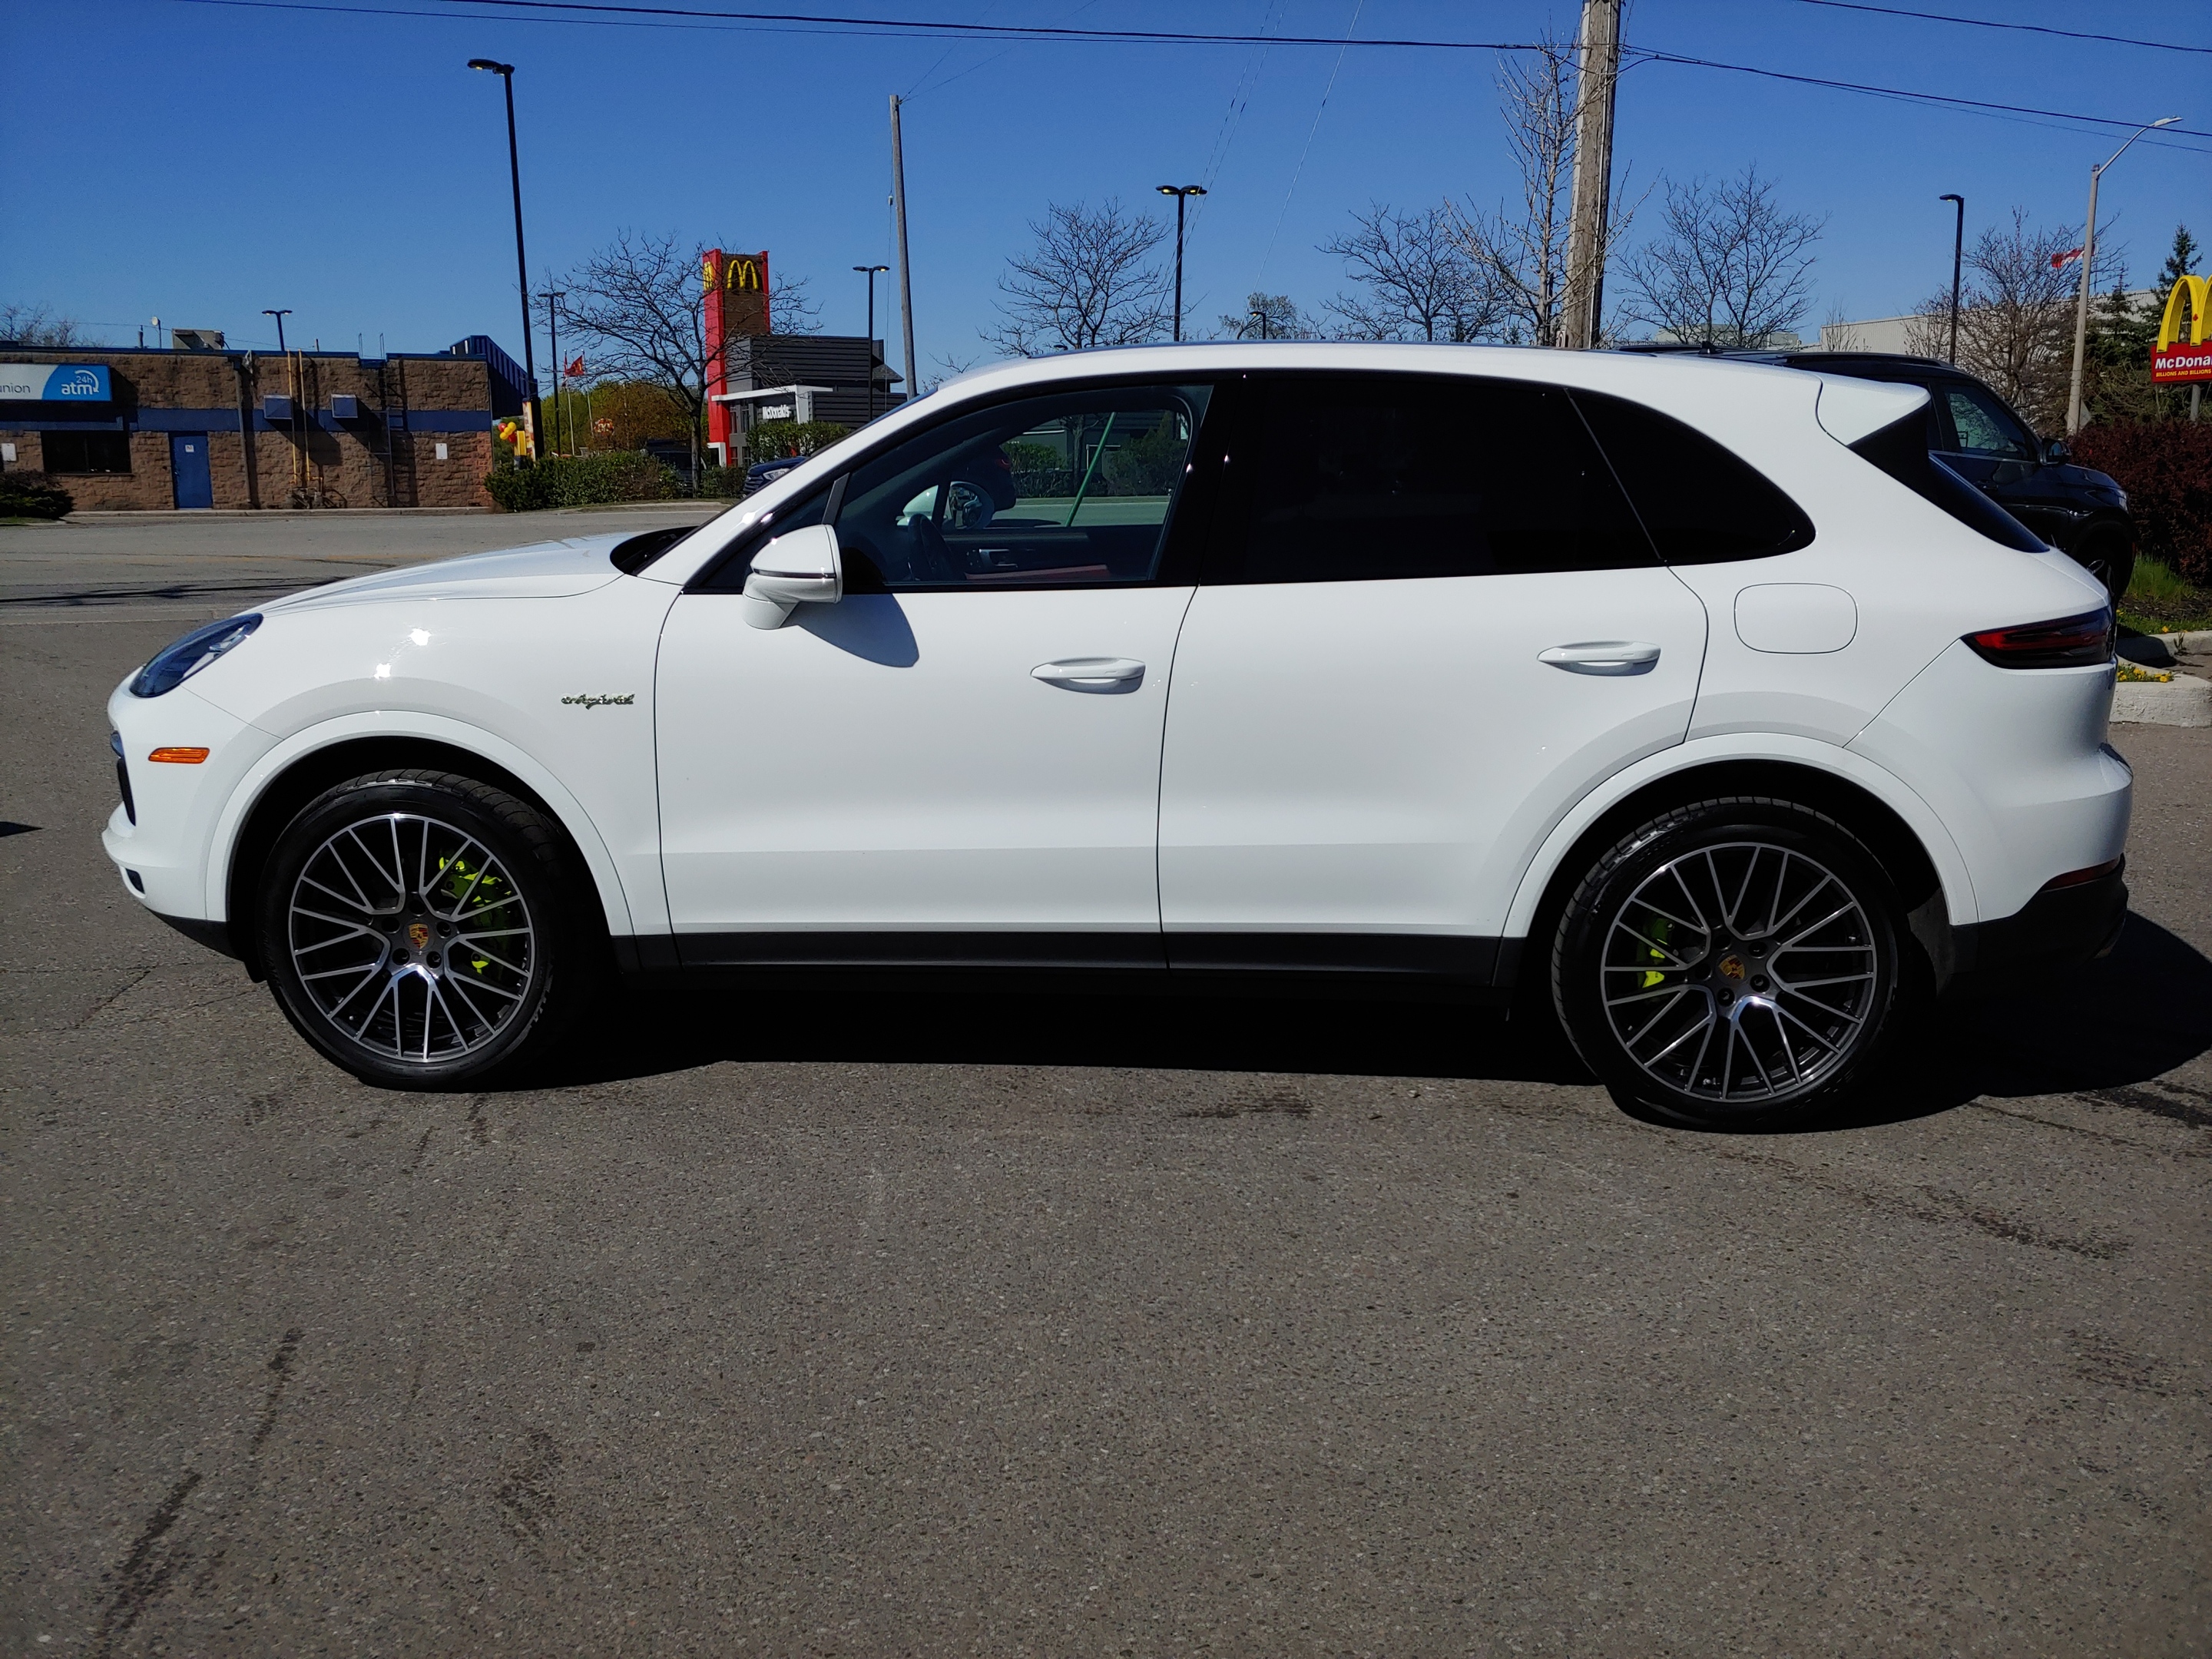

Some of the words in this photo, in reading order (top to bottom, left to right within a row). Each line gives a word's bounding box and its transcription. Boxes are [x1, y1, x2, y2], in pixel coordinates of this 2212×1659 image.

[2154, 355, 2212, 369] McDona
[0, 382, 31, 393] nion
[61, 382, 93, 395] atm
